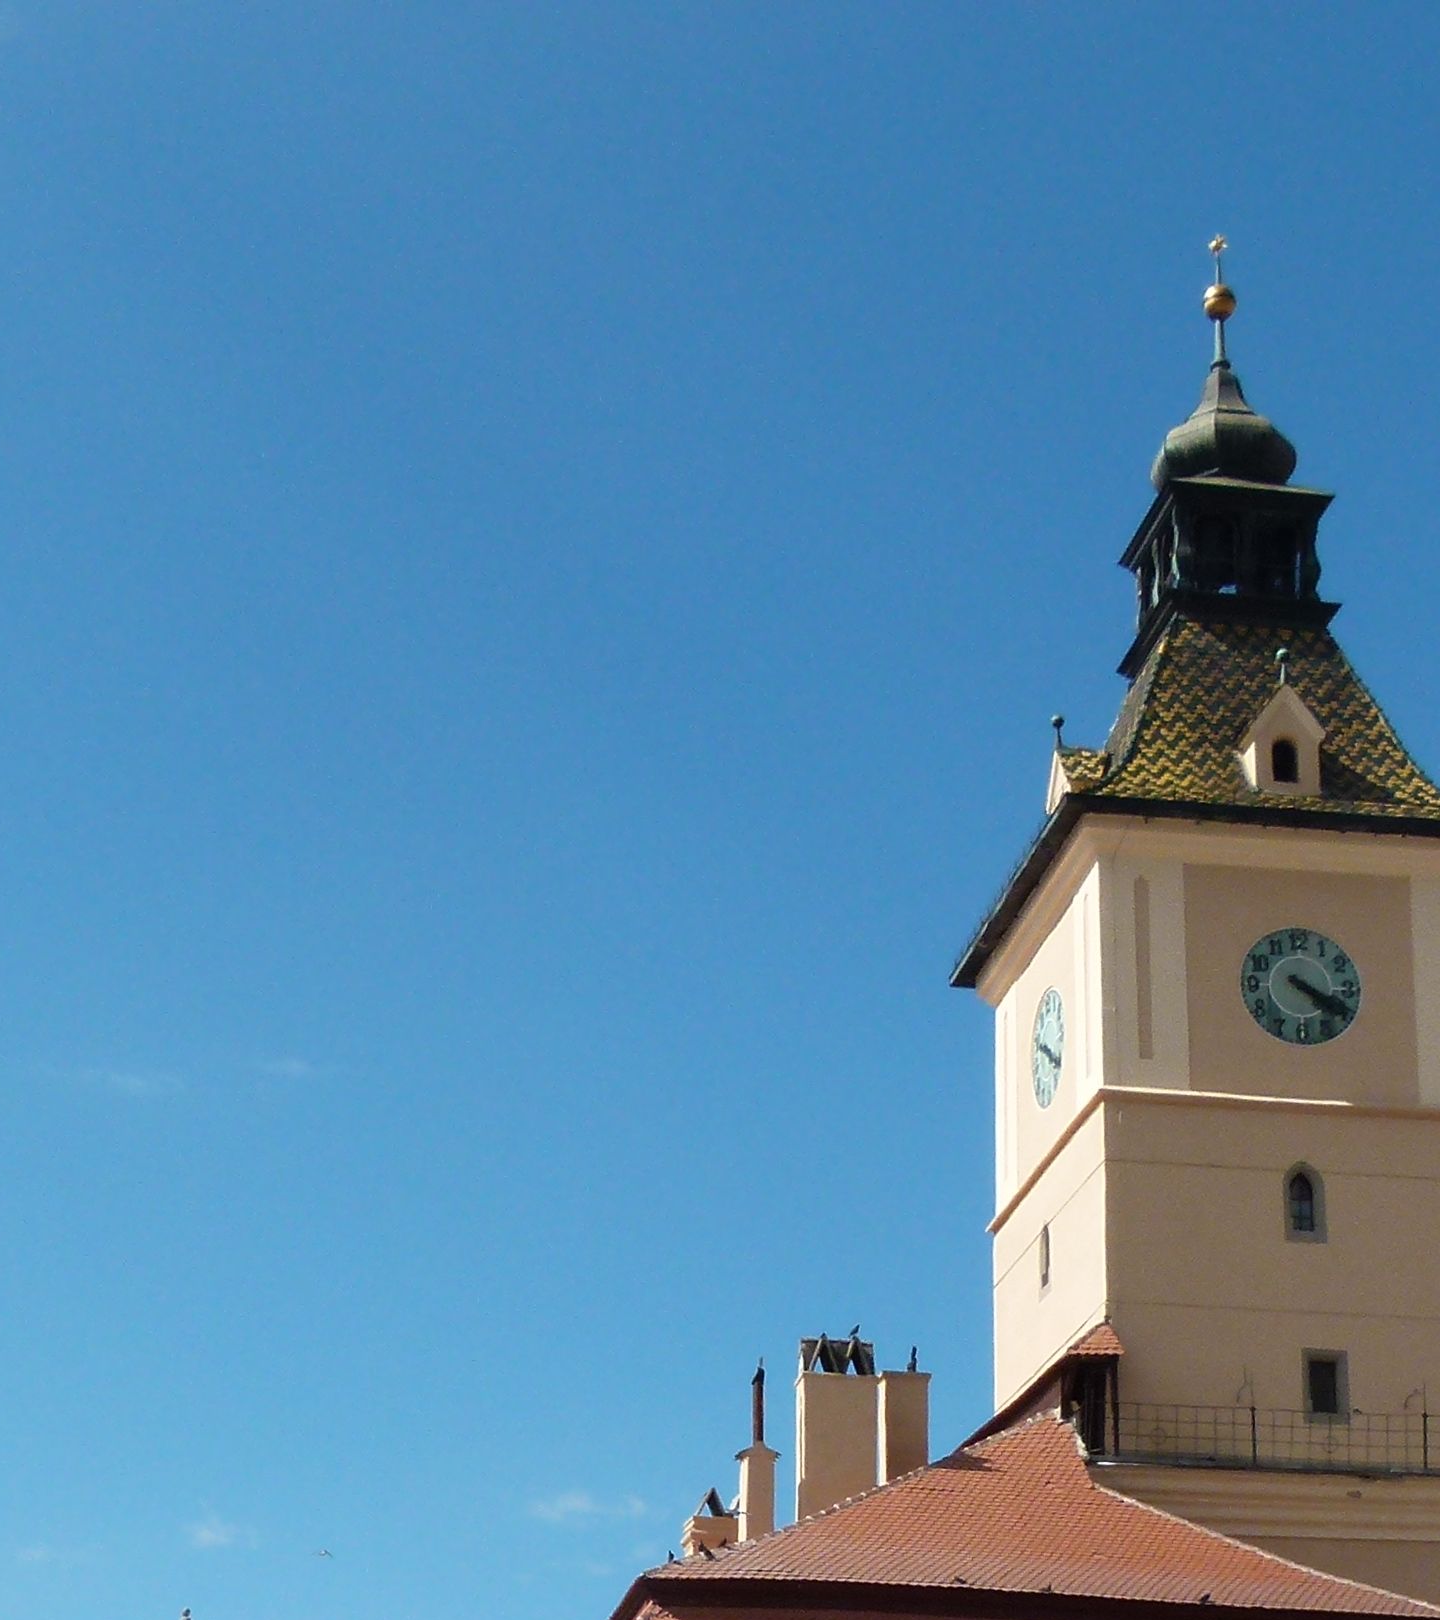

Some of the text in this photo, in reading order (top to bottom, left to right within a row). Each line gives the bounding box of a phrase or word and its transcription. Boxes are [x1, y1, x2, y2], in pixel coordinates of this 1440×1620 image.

[1268, 938, 1283, 956] 11
[1289, 932, 1308, 951] 12
[1316, 940, 1326, 957] 1
[1251, 954, 1269, 972] 10
[1332, 955, 1347, 973] 2
[1246, 974, 1260, 993] 9
[1341, 980, 1354, 998] 3
[1253, 998, 1265, 1017] 8
[1296, 1022, 1309, 1041] 6
